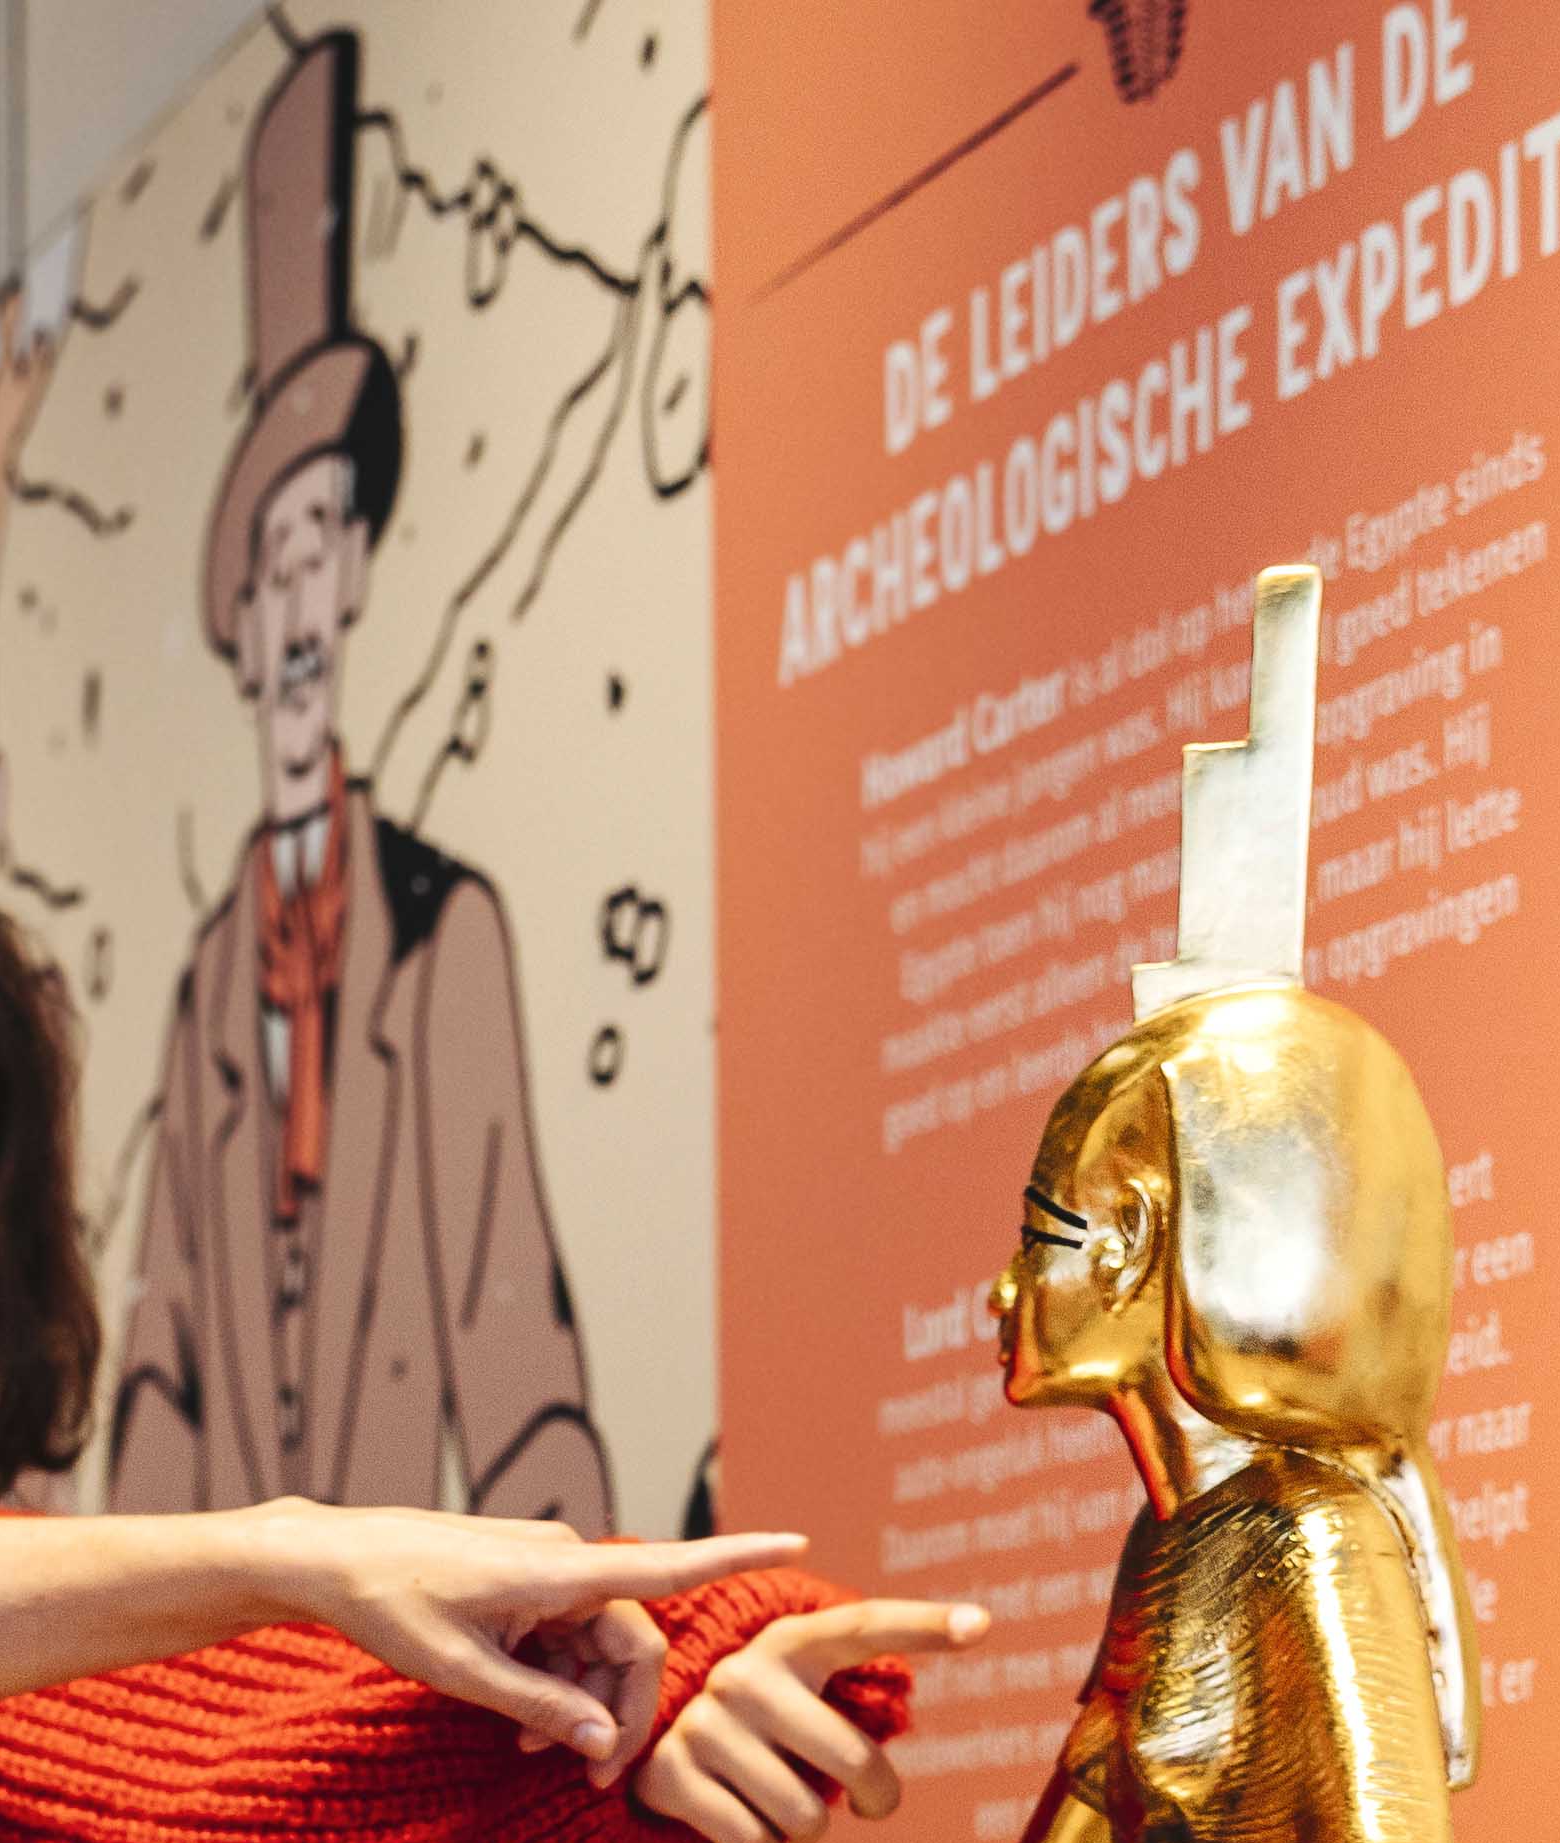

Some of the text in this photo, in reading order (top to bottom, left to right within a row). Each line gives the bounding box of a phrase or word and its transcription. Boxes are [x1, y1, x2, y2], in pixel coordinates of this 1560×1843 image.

[885, 0, 1474, 457] DE LEIDERS VAN DE
[778, 303, 1252, 687] ARCHEOLOGISCHE
[1415, 522, 1549, 614] tekenen
[858, 715, 969, 804] Howard
[970, 671, 1065, 751] Carter
[1344, 485, 1449, 570] Egypte
[1453, 433, 1547, 514] sinds
[1469, 622, 1504, 672] in
[1367, 741, 1441, 798] was.
[1442, 703, 1492, 767] Hij
[1318, 837, 1396, 894] maar
[1397, 808, 1444, 869] hij
[1444, 788, 1523, 850] lette
[1325, 875, 1521, 978] opgravingen
[1470, 1231, 1535, 1284] een
[1454, 1402, 1532, 1453] naar
